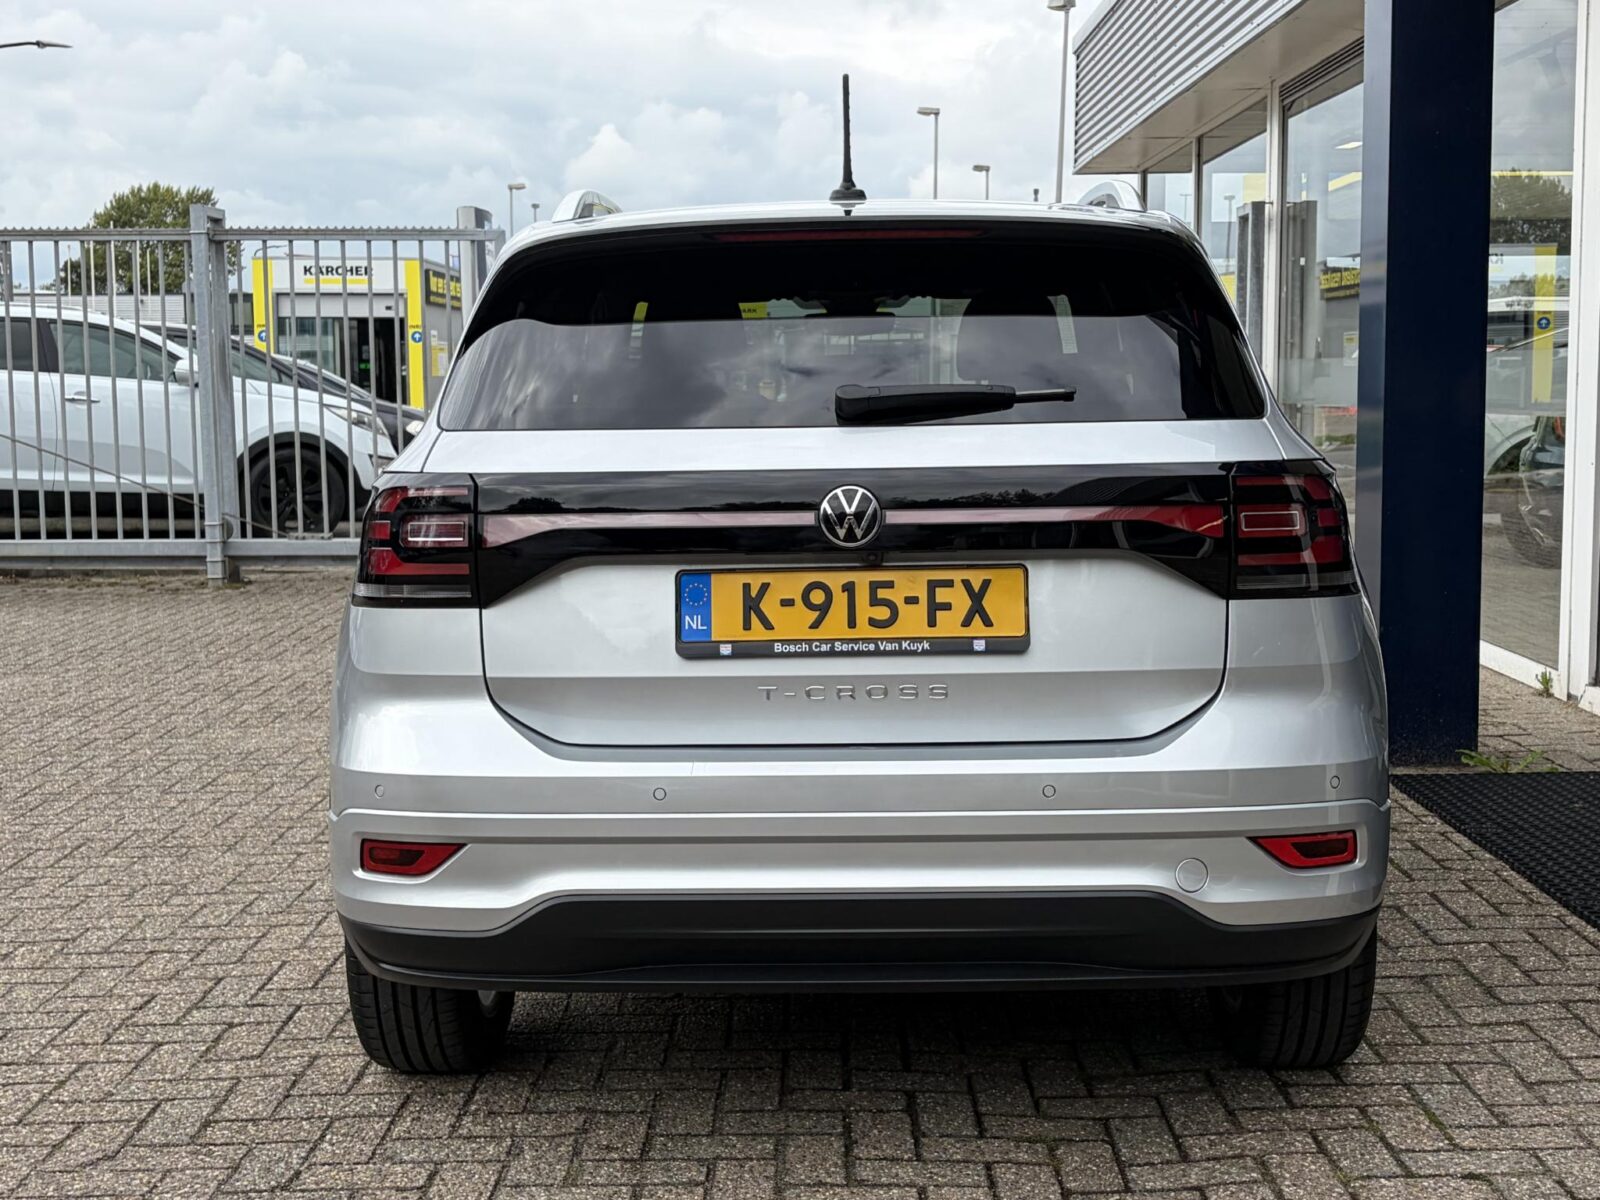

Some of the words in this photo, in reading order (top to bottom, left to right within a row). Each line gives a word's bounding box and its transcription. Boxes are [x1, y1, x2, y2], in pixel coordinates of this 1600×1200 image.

[742, 578, 994, 631] K-915-FX
[684, 614, 708, 630] NL
[774, 642, 809, 653] Bosch
[812, 642, 831, 652] Car
[834, 641, 875, 652] Service
[878, 641, 899, 651] Van
[901, 640, 931, 653] Kuyk
[757, 684, 949, 701] T-CROSS
